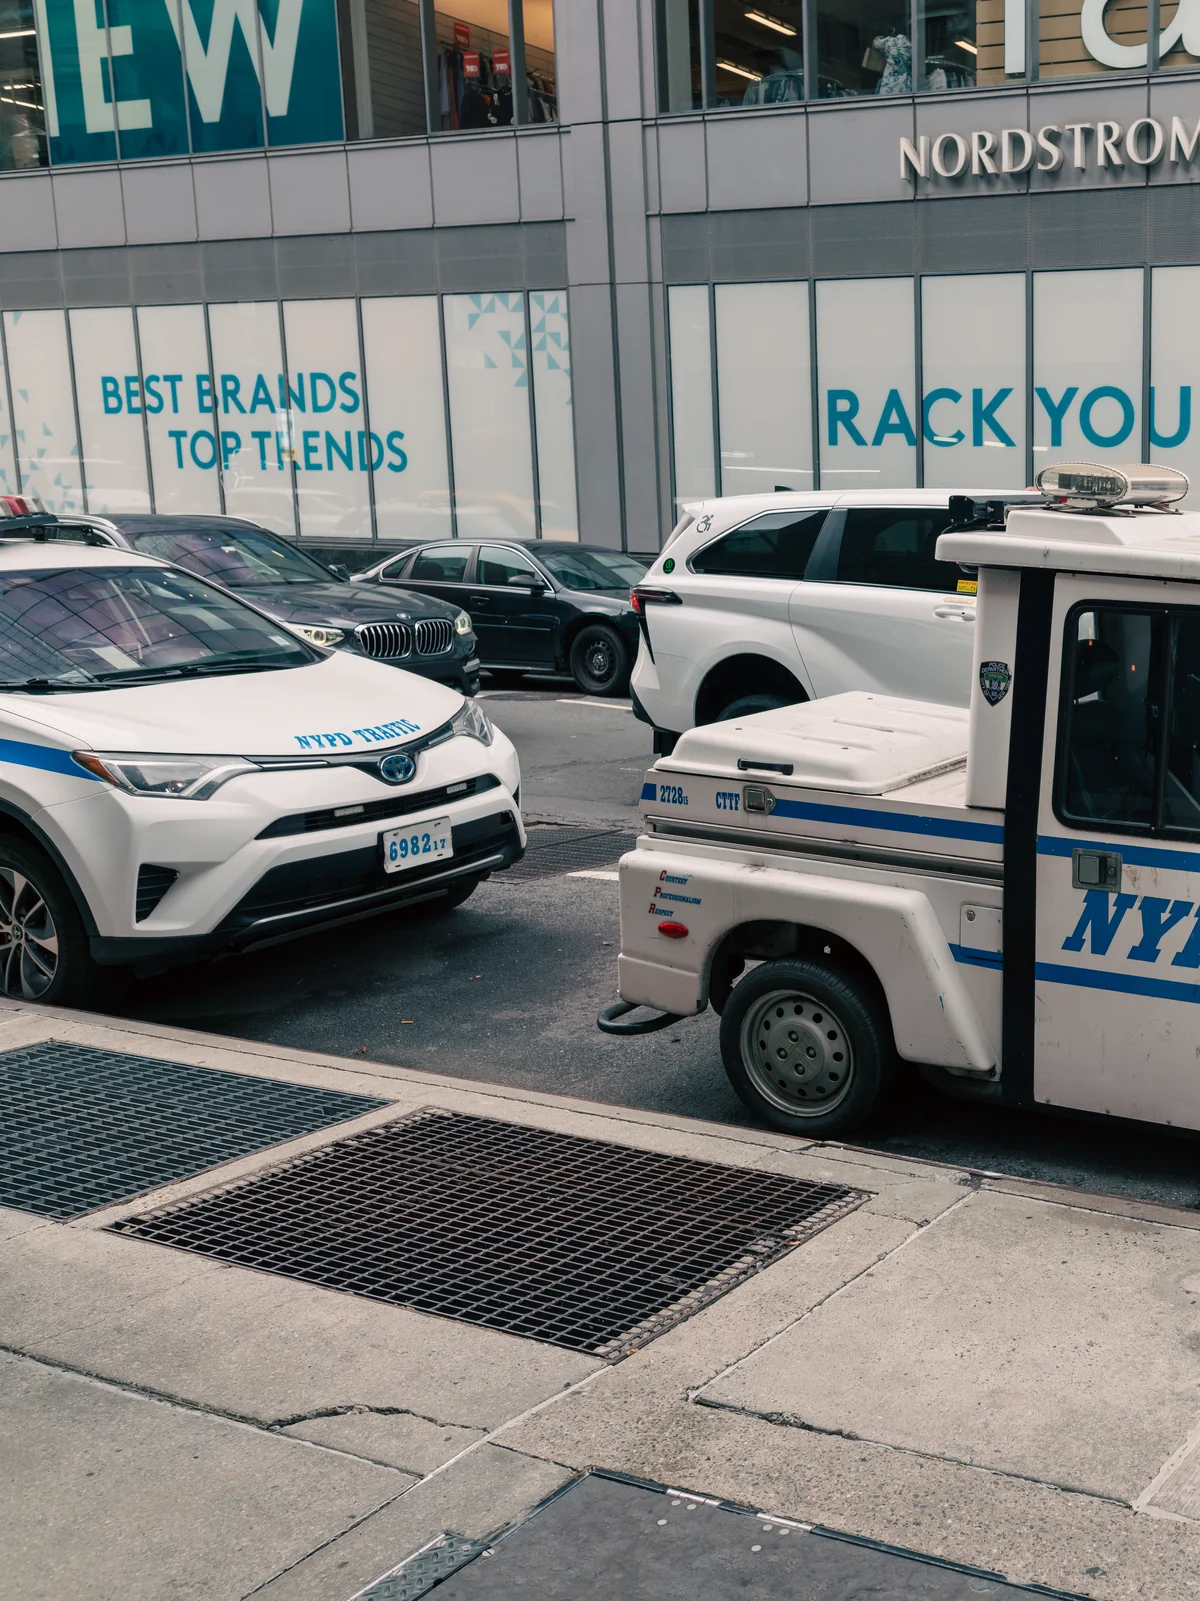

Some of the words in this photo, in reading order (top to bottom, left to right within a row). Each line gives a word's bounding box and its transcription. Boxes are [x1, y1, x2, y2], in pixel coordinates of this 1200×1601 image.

[36, 0, 303, 137] EW
[101, 374, 183, 414] BEST
[196, 371, 360, 414] BRANDS
[827, 387, 1015, 447] RACK
[168, 430, 241, 470] TOP
[294, 732, 353, 750] NYPD
[352, 718, 421, 743] TRAFFIC
[660, 785, 683, 805] 2728
[683, 795, 689, 806] 15
[715, 791, 740, 811] CTTF
[389, 833, 432, 862] 6982
[433, 838, 446, 851] 17
[659, 870, 688, 885] COURTESY
[648, 903, 674, 917] RESPECT
[653, 886, 702, 905] PROFESSIONALISM
